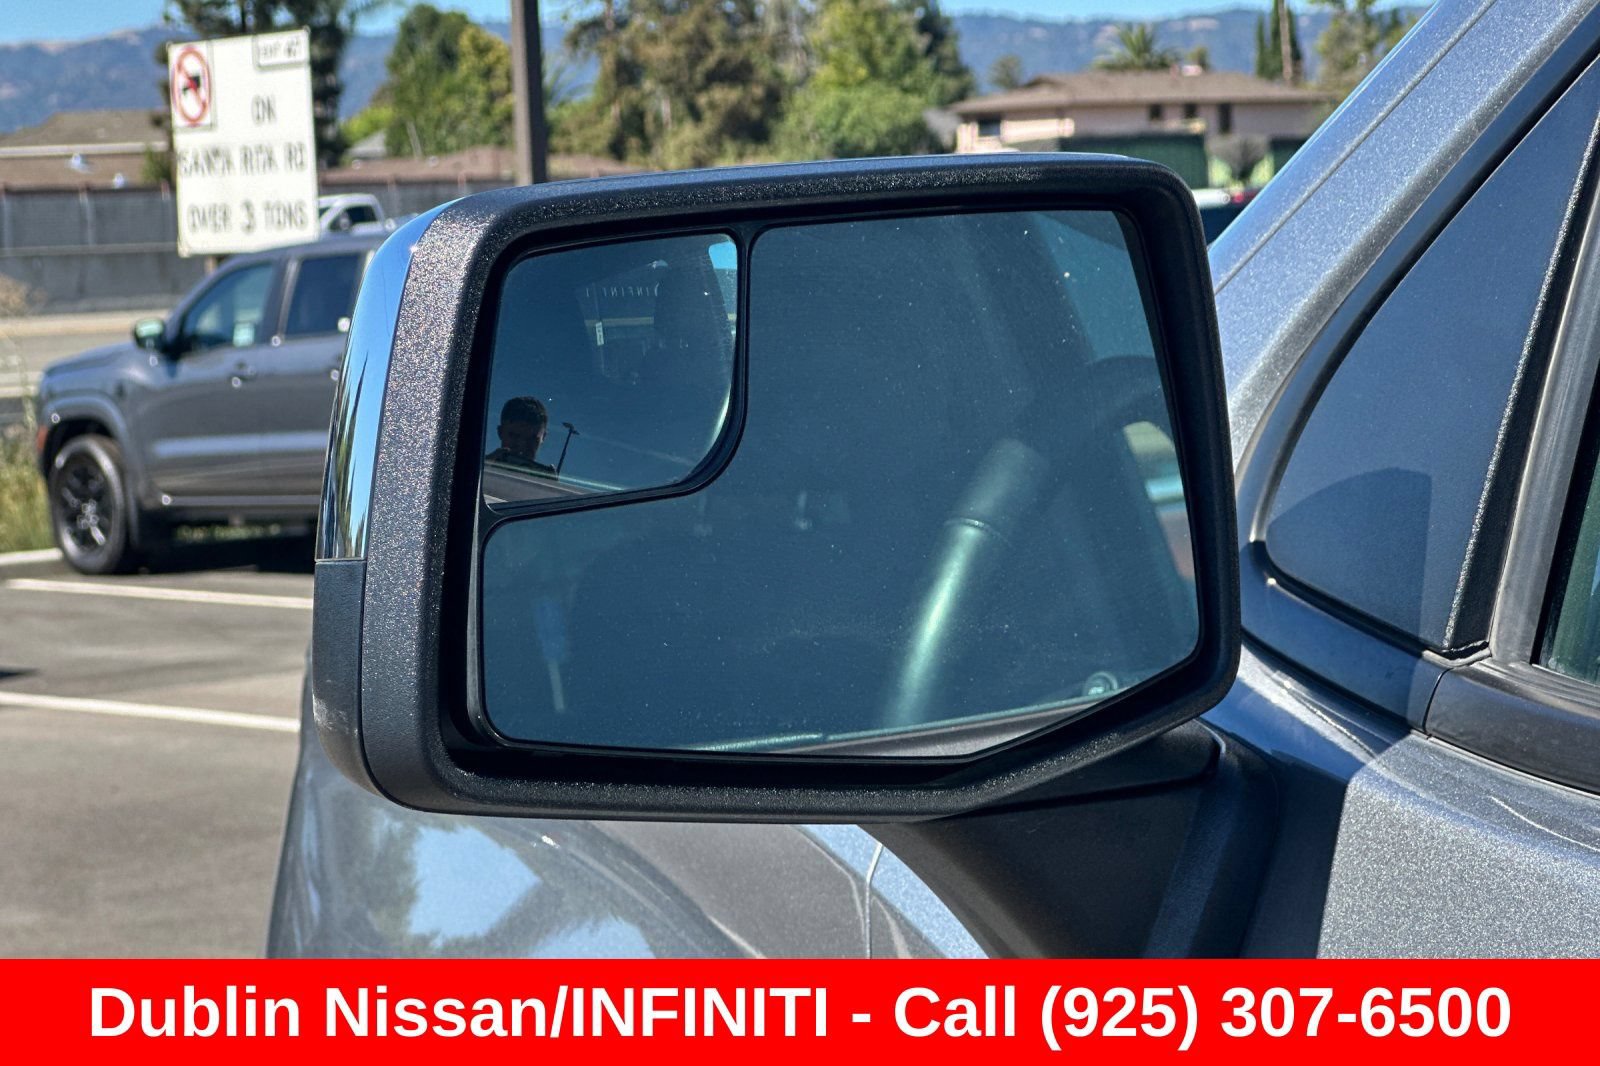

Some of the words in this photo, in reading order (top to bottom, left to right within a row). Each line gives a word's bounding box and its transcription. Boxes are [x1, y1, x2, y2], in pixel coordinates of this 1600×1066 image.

[178, 145, 234, 176] SANTA
[240, 143, 277, 175] RITA
[188, 203, 232, 232] OVER
[241, 200, 255, 233] 3
[263, 200, 308, 230] TONS
